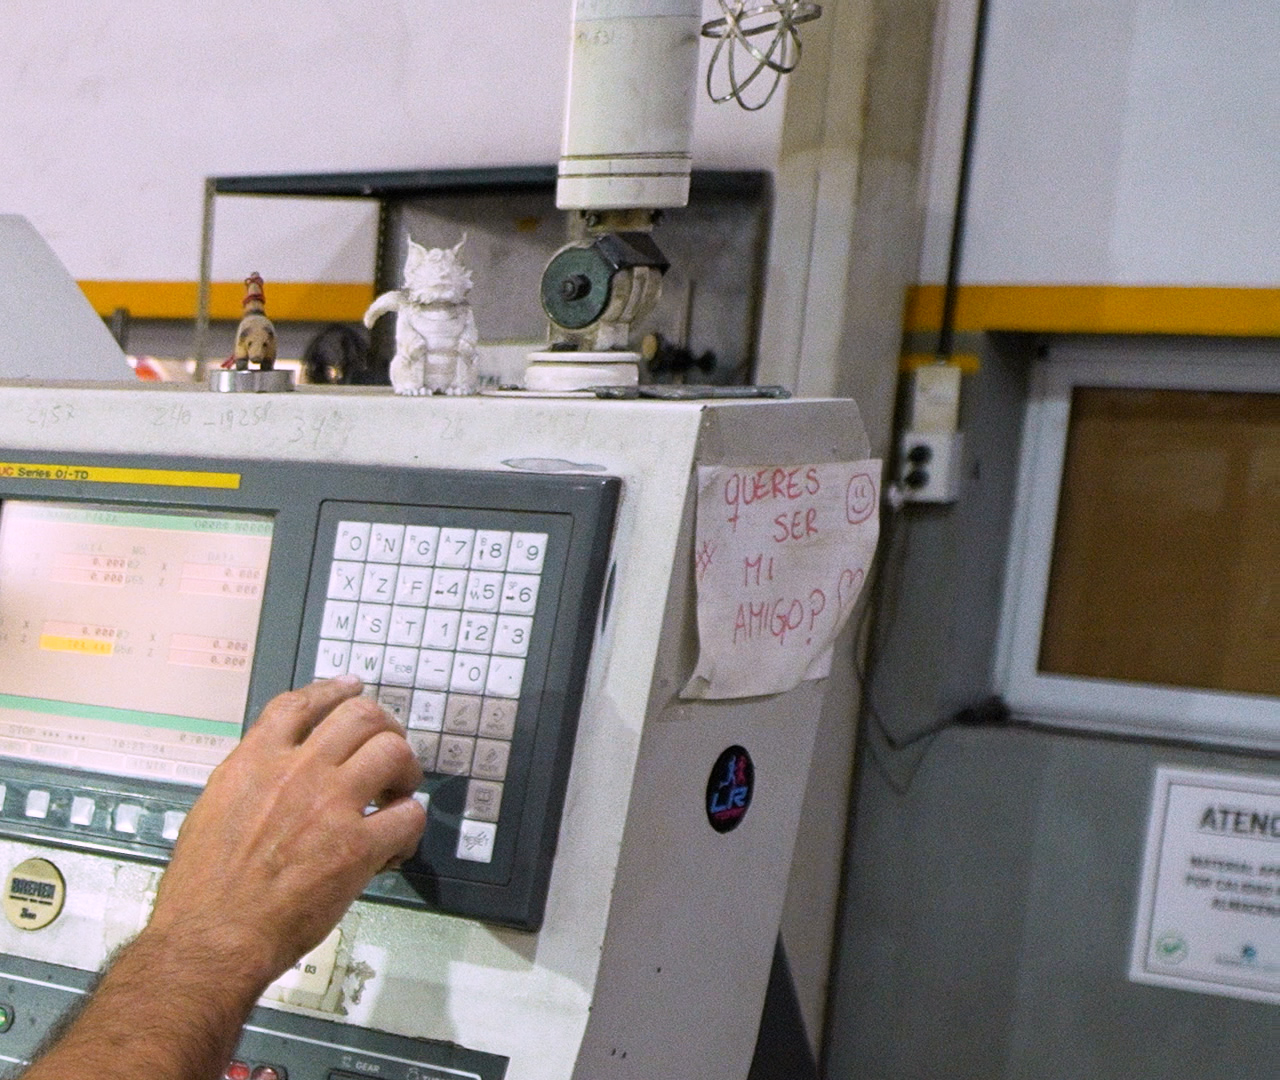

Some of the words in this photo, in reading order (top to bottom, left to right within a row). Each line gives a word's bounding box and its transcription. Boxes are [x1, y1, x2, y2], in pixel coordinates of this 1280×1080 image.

[18, 467, 51, 478] Series
[725, 468, 820, 533] QUERES
[773, 508, 818, 543] SER
[455, 540, 467, 555] 7
[489, 543, 502, 558] 8
[526, 545, 539, 560] 9
[744, 553, 773, 587] MI
[447, 582, 459, 597] 4
[483, 584, 495, 600] 5
[519, 587, 532, 603] 6
[732, 589, 826, 645] AMIGO?
[370, 618, 382, 633] S
[406, 621, 417, 636] T
[441, 623, 449, 637] 1
[475, 625, 489, 641] 2
[512, 628, 525, 644] 3
[332, 653, 344, 668] U
[365, 656, 378, 671] W
[355, 1061, 381, 1073] GEAR
